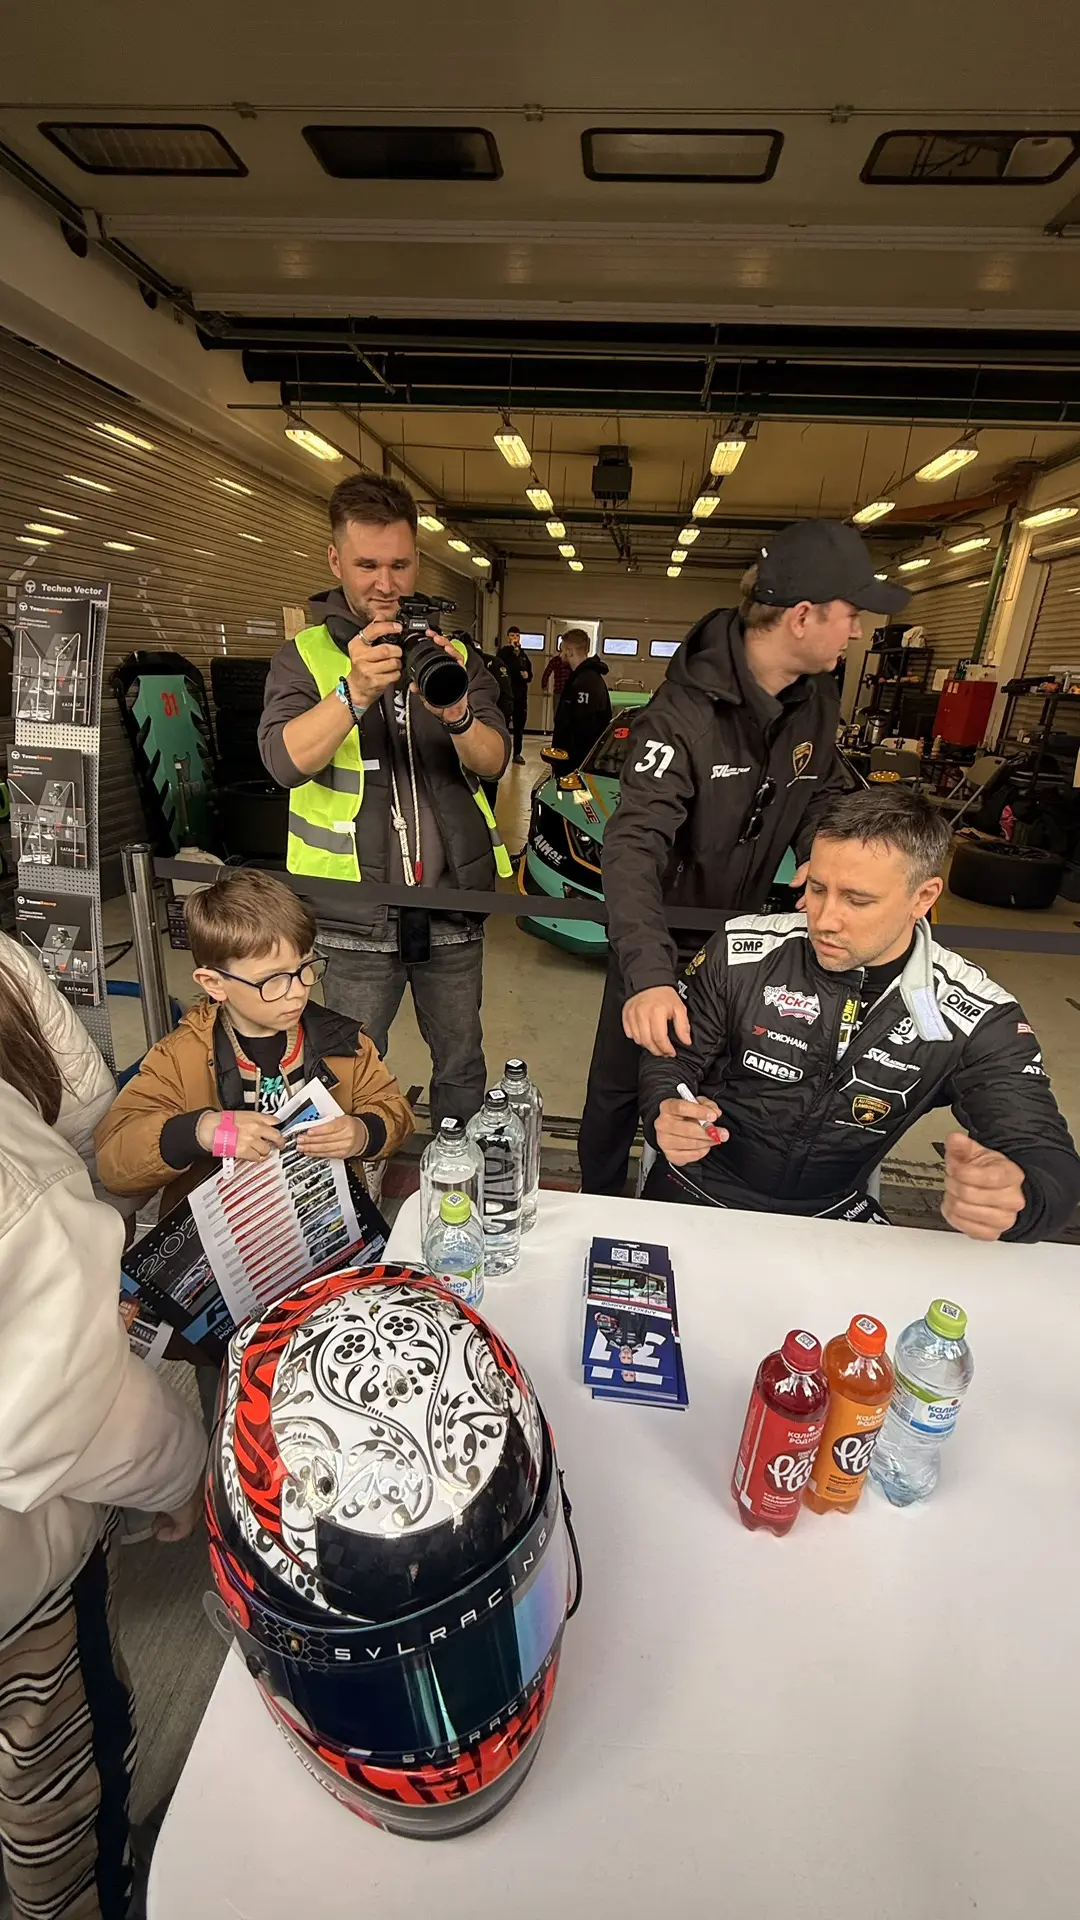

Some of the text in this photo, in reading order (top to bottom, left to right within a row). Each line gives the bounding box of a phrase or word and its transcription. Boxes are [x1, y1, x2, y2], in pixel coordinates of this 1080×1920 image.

[41, 583, 102, 595] Techno Vector
[577, 692, 590, 704] 31
[634, 739, 675, 778] 31
[732, 941, 763, 952] OMP
[842, 999, 855, 1022] OMP
[946, 994, 982, 1018] OMP
[767, 1030, 808, 1052] YOKOHAMA
[745, 1055, 799, 1080] AIMOL
